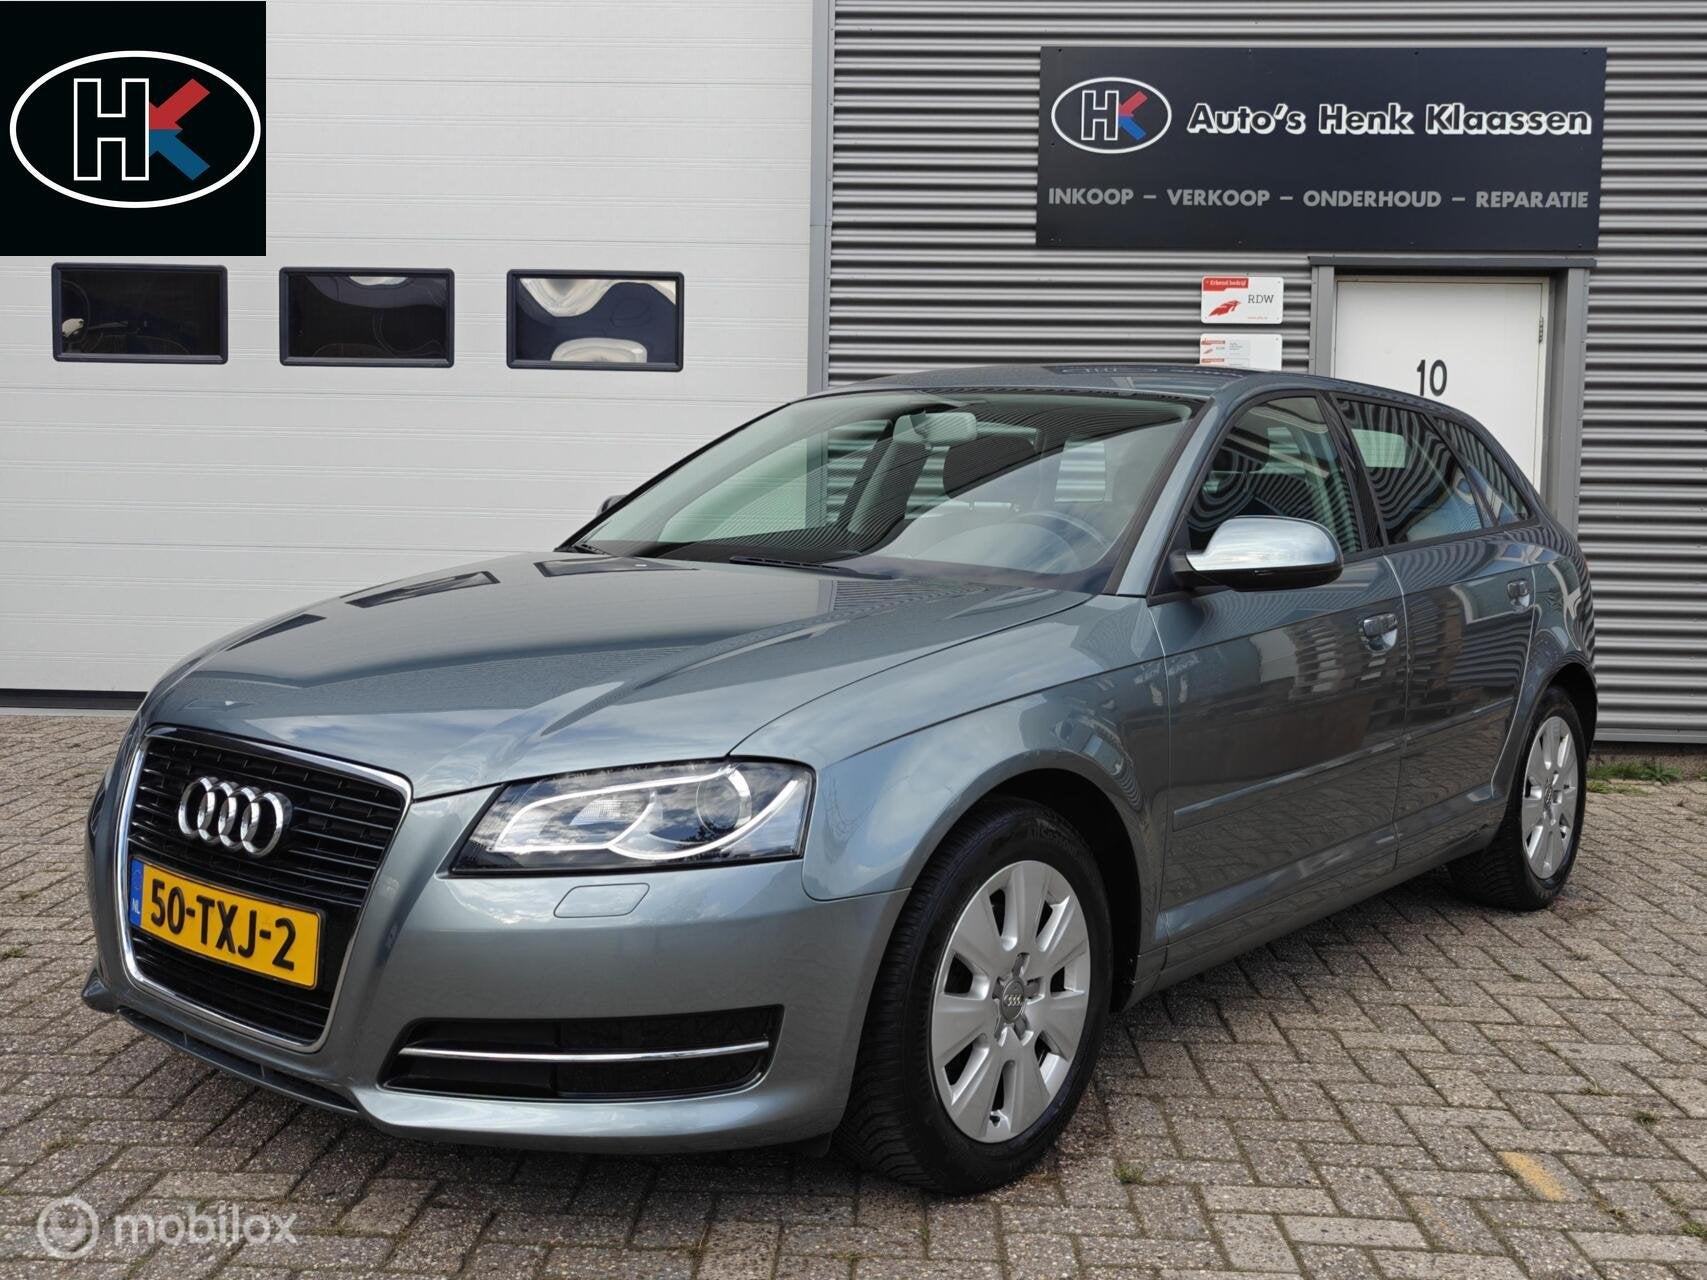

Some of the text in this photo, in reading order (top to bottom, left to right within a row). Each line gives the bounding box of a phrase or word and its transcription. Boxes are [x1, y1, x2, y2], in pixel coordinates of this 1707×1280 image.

[1187, 102, 1592, 136] Auto's Henk Klaassen
[1048, 187, 1134, 206] INKOOP
[1167, 188, 1270, 208] VERKOOP
[1303, 190, 1442, 209] ONDERHOUD
[1476, 191, 1589, 210] REPARATIE
[1247, 294, 1275, 305] RDW
[1416, 359, 1448, 397] 10
[132, 899, 140, 914] NL
[150, 878, 296, 972] 50-TXJ-2
